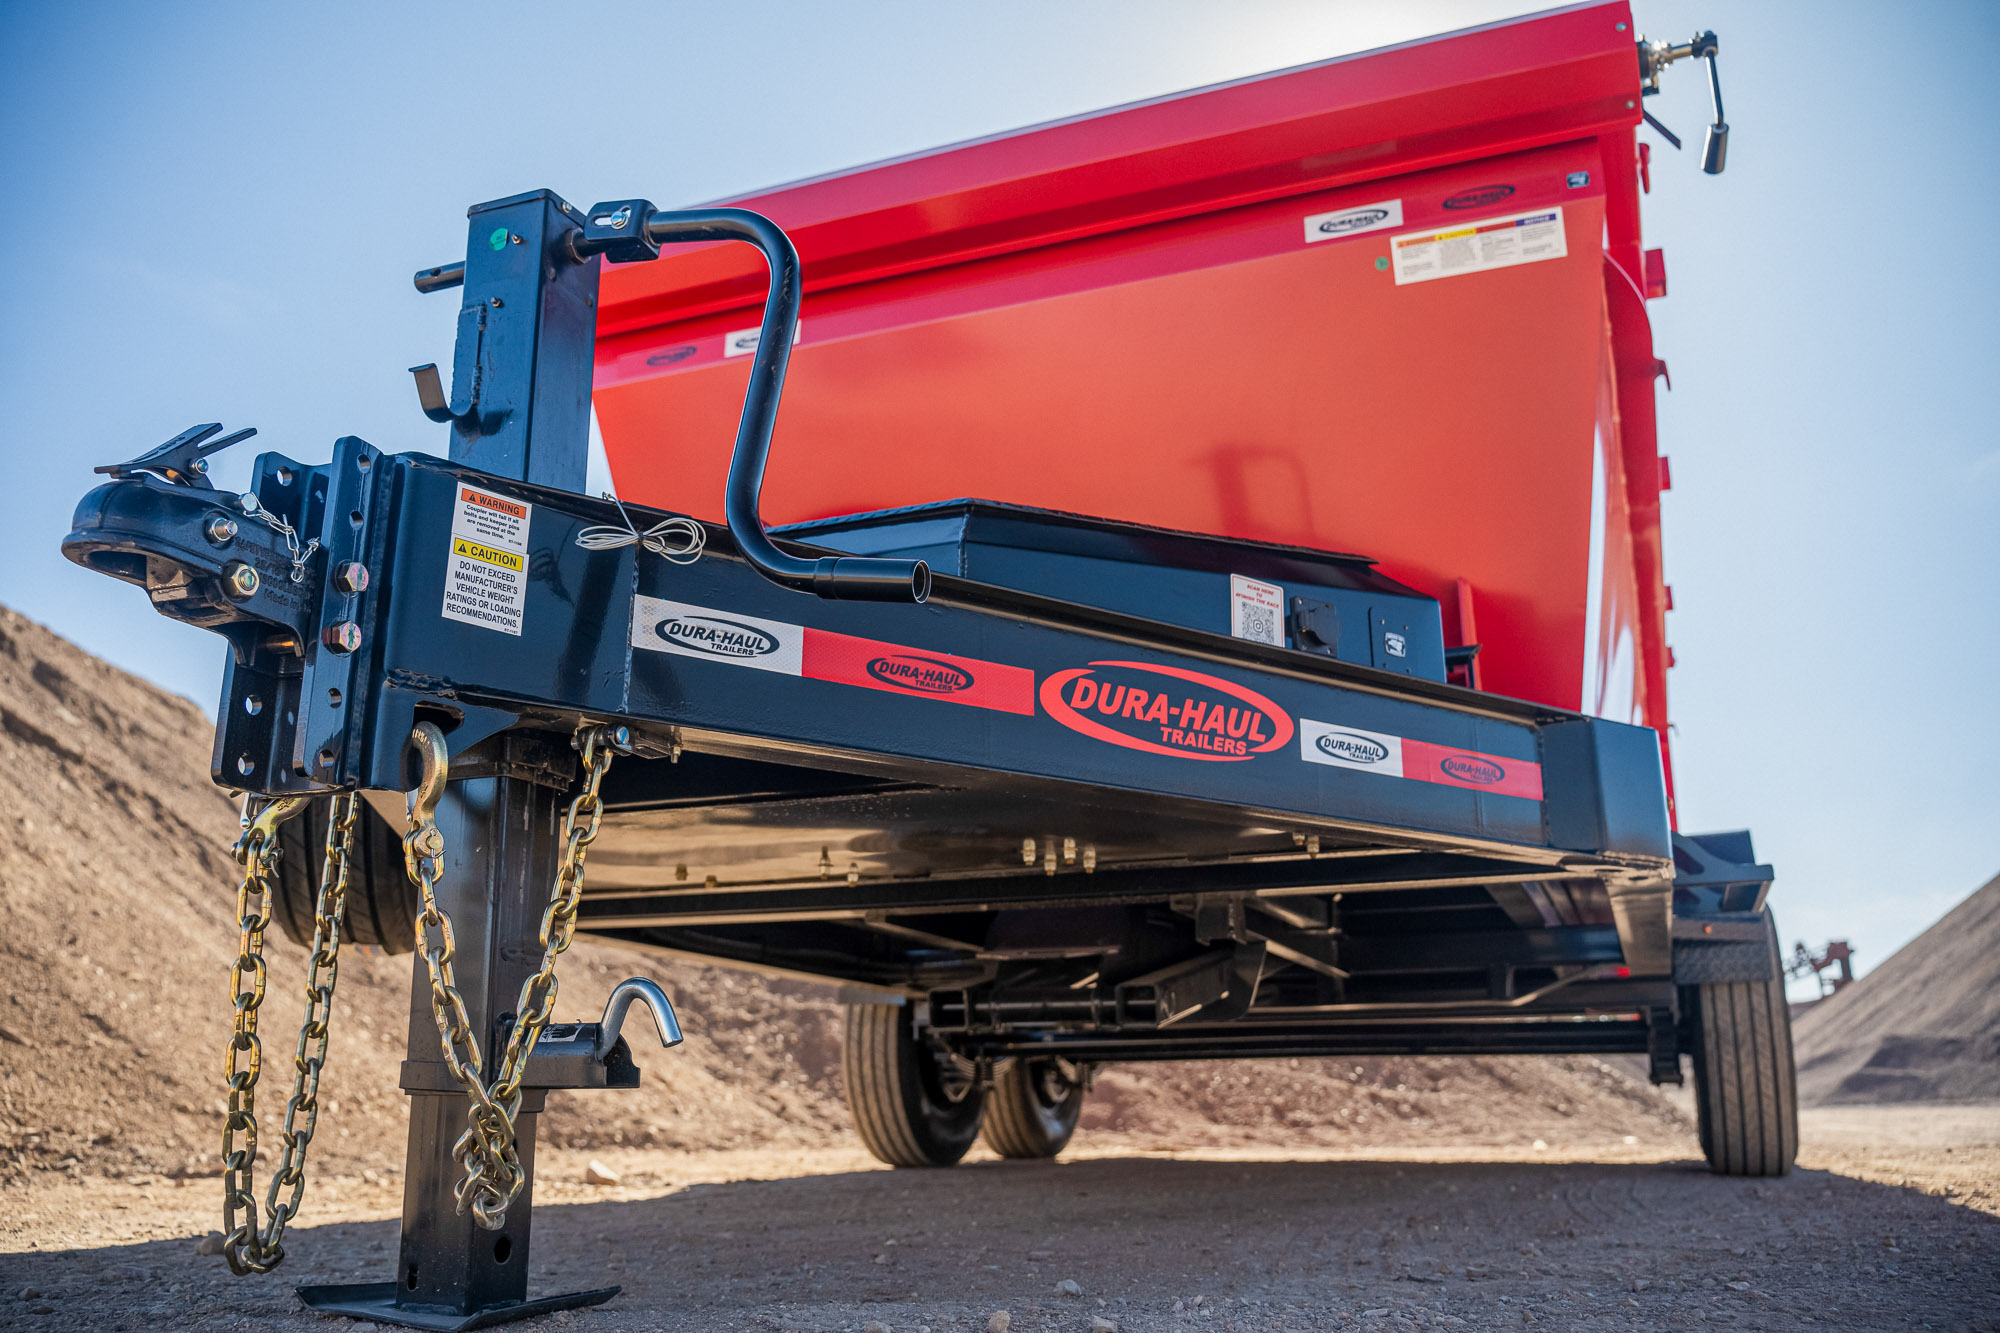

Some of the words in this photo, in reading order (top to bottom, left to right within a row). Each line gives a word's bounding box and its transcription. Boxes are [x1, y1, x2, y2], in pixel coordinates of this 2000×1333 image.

[466, 504, 487, 514] Coupler
[479, 495, 520, 515] WARNING
[464, 510, 477, 518] bolts
[489, 518, 507, 527] keeper
[476, 521, 500, 531] removed
[491, 531, 505, 539] time.
[471, 546, 517, 567] CAUTION
[460, 560, 471, 570] DO
[472, 564, 487, 575] NOT
[488, 568, 516, 583] EXCEED
[454, 571, 518, 595] MANUFACTURER'S
[456, 582, 486, 598] VEHICLE
[487, 590, 515, 605] WEIGHT
[446, 591, 477, 607] RATINGS
[478, 600, 489, 609] OR
[490, 603, 521, 618] LOADING
[446, 603, 519, 629] RECOMMENDATIONS.
[668, 620, 765, 651] DURA-HAUL
[710, 642, 755, 656] TRAILERS
[877, 661, 962, 688] DURA-HAUL
[915, 679, 954, 692] TRAILERS
[1070, 677, 1267, 743] DURA-HAUL
[1160, 726, 1248, 756] TRAILERS
[1323, 737, 1381, 758] DURA-HAUL
[1349, 753, 1375, 762] TRAILERS
[1447, 760, 1499, 778] DURA-HAUL
